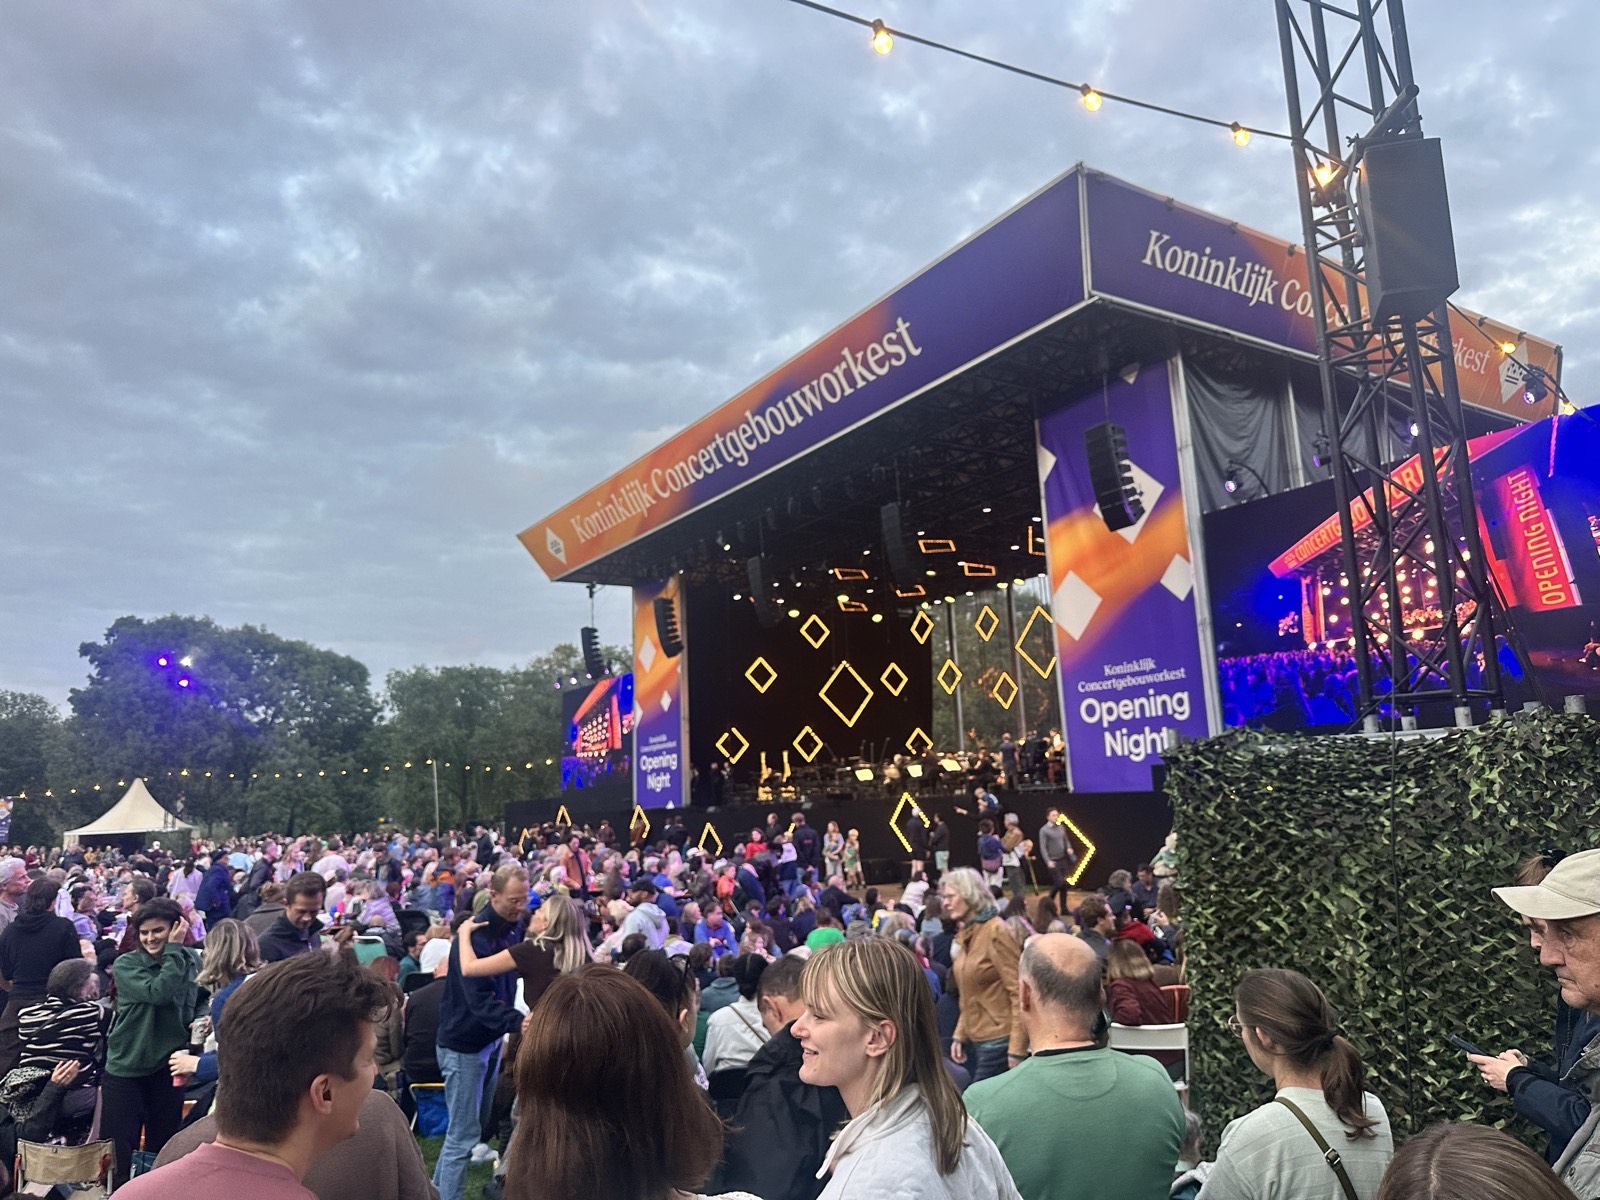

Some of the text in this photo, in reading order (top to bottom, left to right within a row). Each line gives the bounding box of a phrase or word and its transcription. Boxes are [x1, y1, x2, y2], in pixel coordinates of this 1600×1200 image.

[1142, 230, 1279, 306] Koninklijk
[570, 316, 922, 543] Koninklijk Concertgebouworkest
[1507, 470, 1566, 605] OPENING NIGHT
[1077, 667, 1186, 693] Concertgebouworkest
[1103, 657, 1156, 676] Koninklijk
[1080, 688, 1190, 728] Opening
[640, 751, 678, 773] Opening
[1104, 726, 1169, 762] Night
[646, 771, 671, 793] Night
